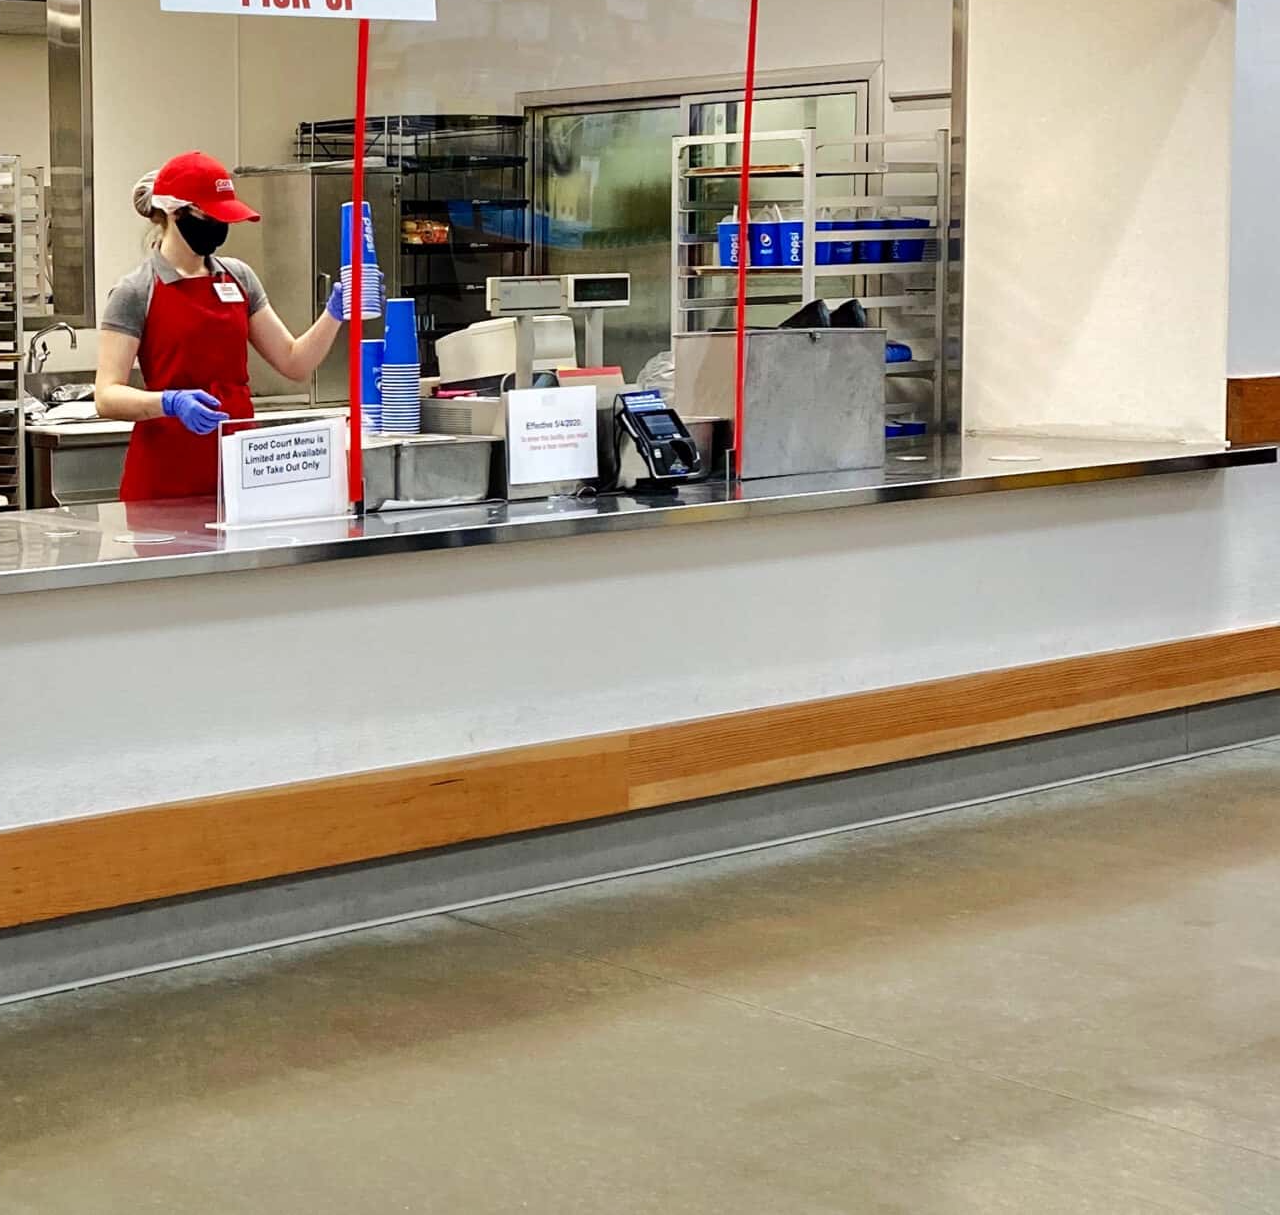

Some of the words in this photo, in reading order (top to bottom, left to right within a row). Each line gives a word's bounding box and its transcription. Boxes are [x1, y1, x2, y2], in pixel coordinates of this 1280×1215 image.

[248, 441, 269, 451] Food
[270, 439, 292, 449] Court
[294, 437, 315, 446] Menu
[317, 435, 324, 443] is
[245, 453, 274, 465] Limited
[276, 451, 291, 461] and
[292, 448, 327, 458] Available
[253, 467, 264, 476] for
[266, 465, 284, 474] Take
[285, 462, 300, 472] Out
[301, 460, 320, 470] Only
